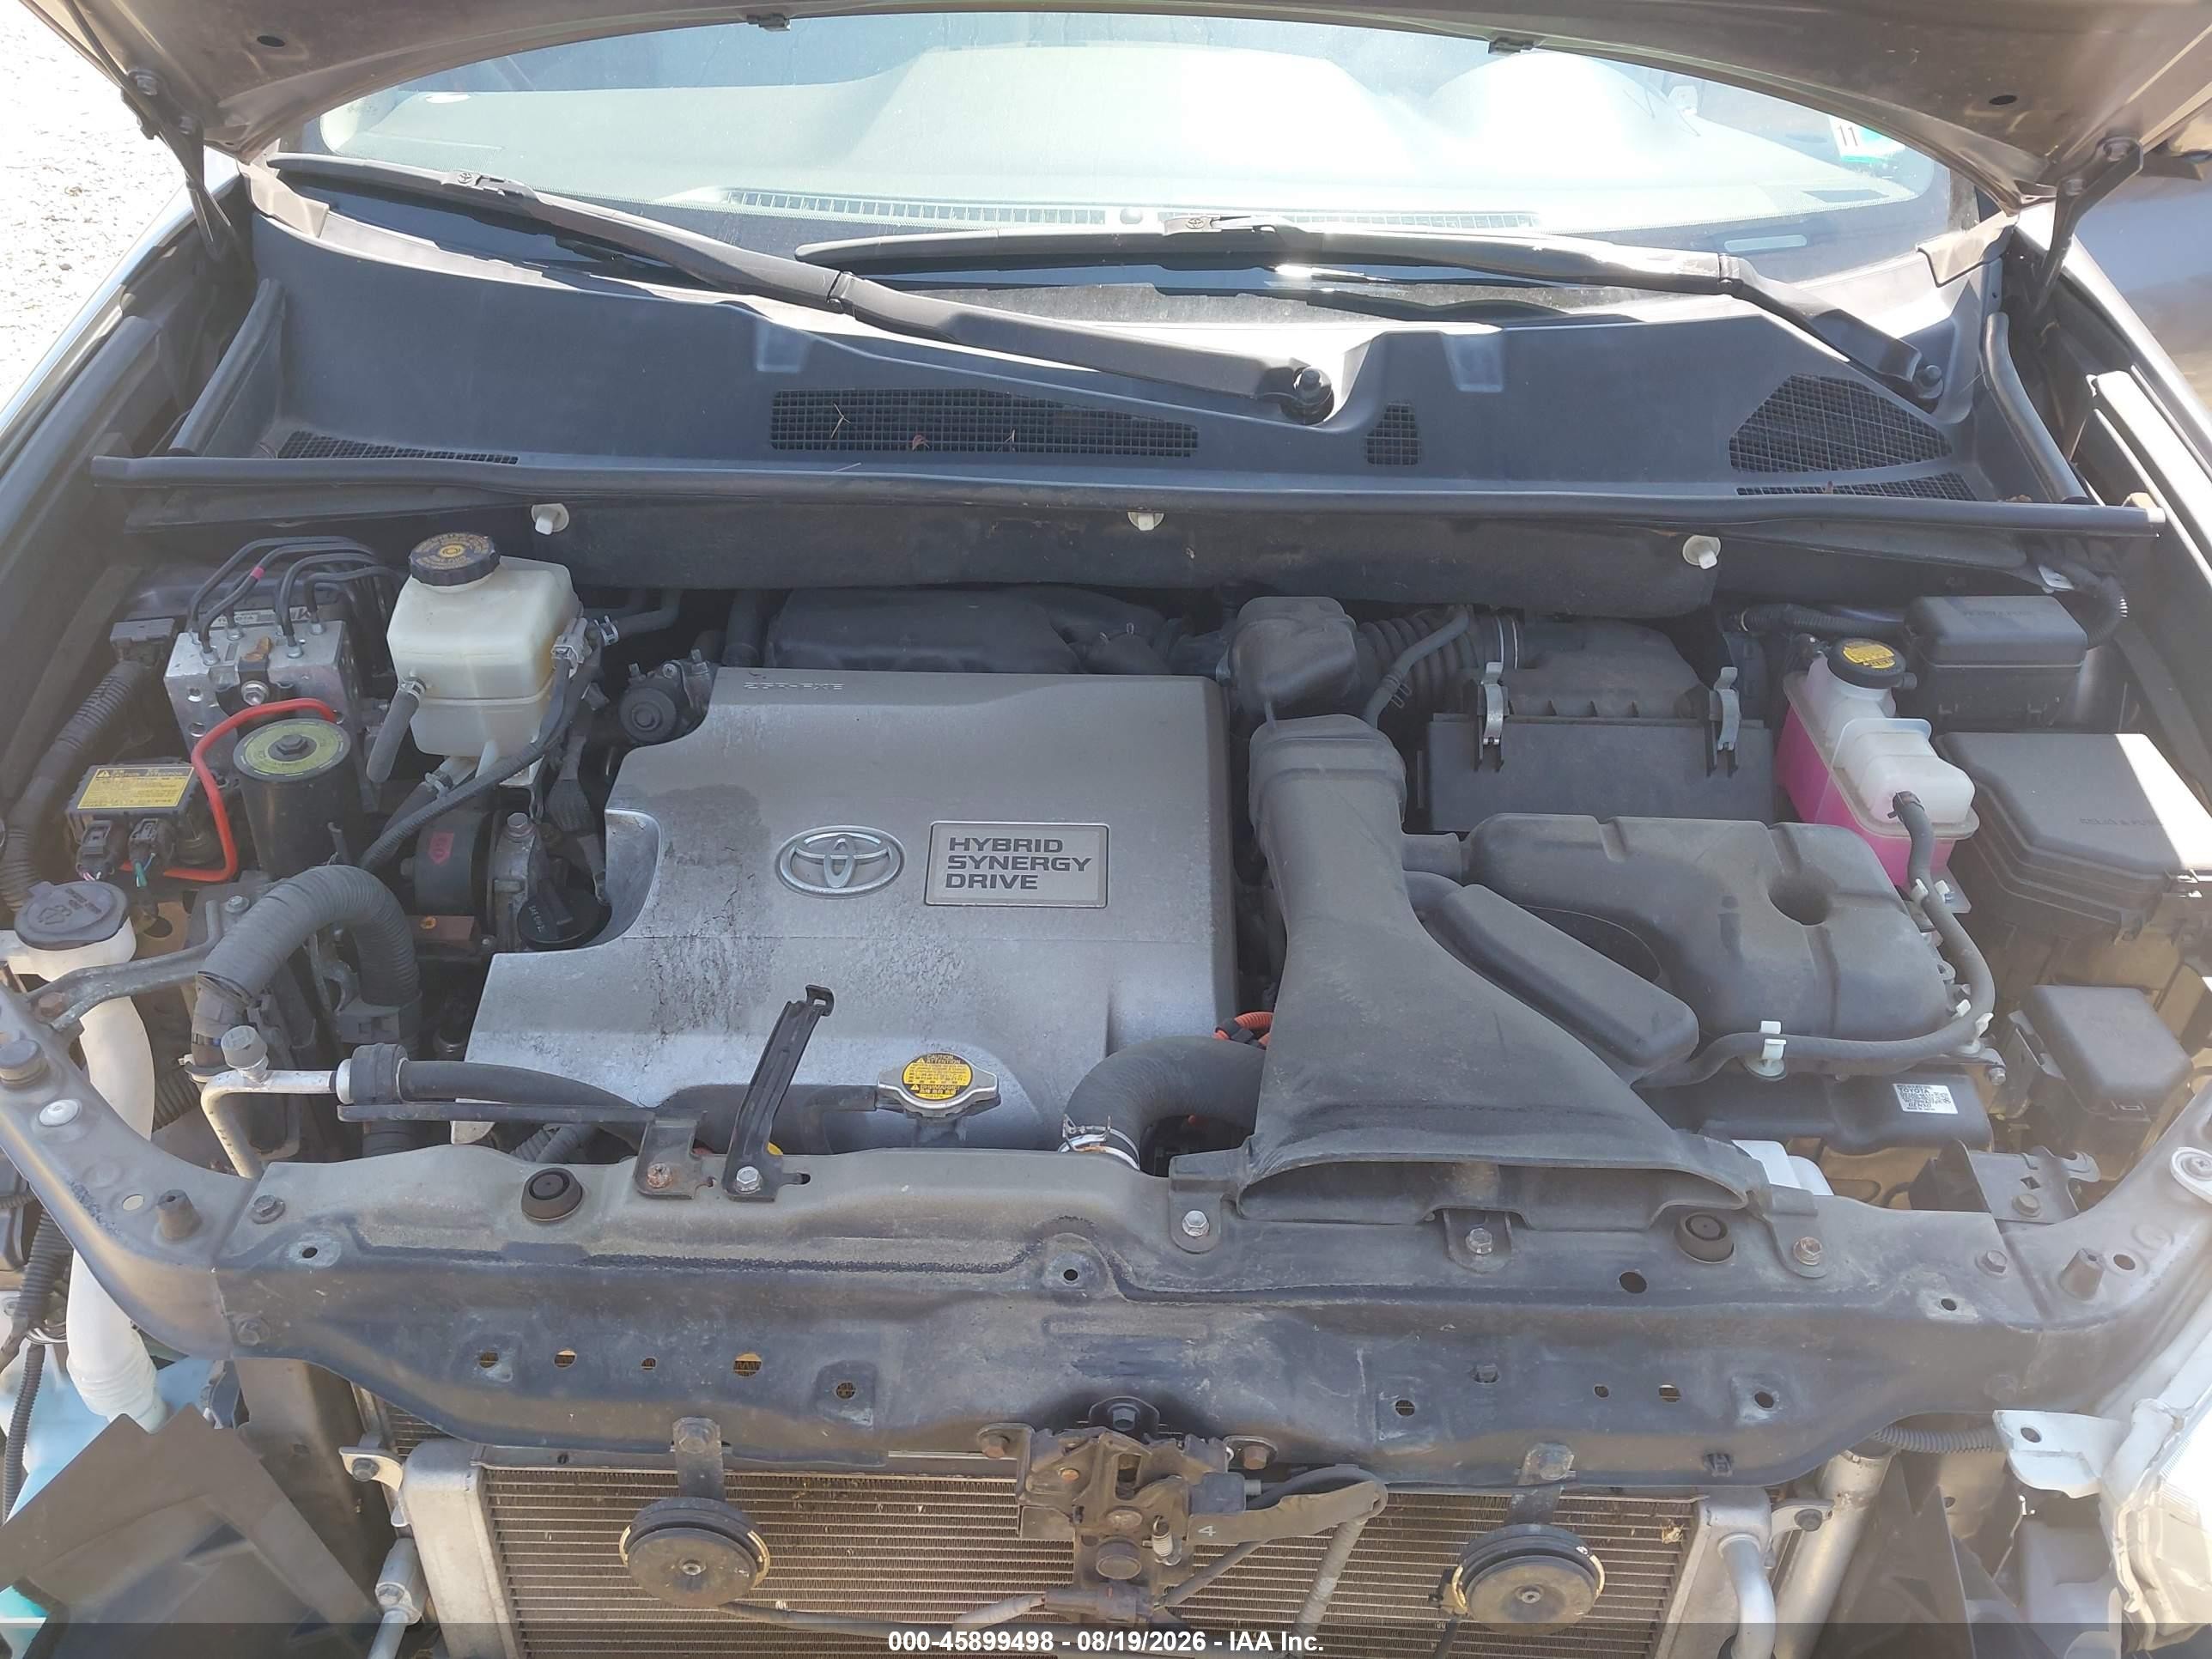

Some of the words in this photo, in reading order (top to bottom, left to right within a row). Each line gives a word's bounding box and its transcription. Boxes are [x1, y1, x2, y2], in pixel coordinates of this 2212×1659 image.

[1838, 125, 1858, 147] 11
[949, 837, 1064, 853] HYBRID
[947, 854, 1092, 872] SYNERGY
[945, 873, 1038, 890] DRIVE
[1198, 1525, 1217, 1537] 4
